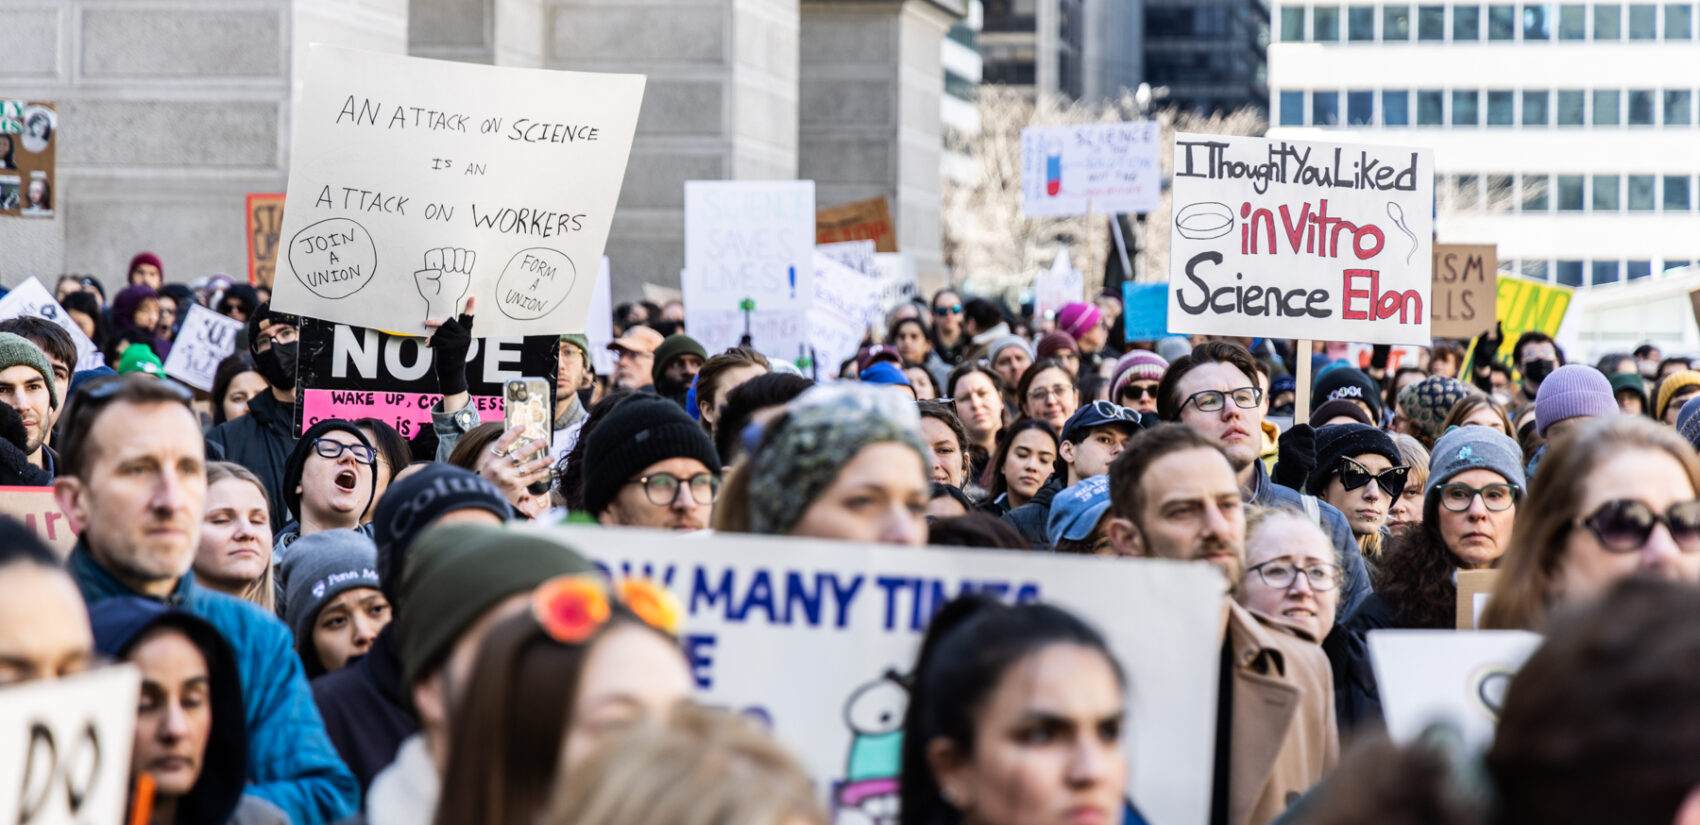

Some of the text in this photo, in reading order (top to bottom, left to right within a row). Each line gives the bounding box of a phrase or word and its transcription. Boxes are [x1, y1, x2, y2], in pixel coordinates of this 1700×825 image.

[336, 95, 600, 144] AN ATTACK ON SCIENCE
[432, 157, 487, 176] IS AN
[1176, 141, 1418, 195] I Thought You Liked
[316, 185, 587, 238] ATTACK ON WORKERS
[298, 227, 355, 255] JOIN
[704, 227, 796, 263] SAVES
[1241, 199, 1386, 261] in Vitro
[328, 250, 340, 265] A
[520, 253, 557, 281] FORM
[1432, 252, 1484, 284] ISM
[306, 264, 361, 288] UNION
[528, 277, 541, 292] A
[1176, 250, 1424, 325] Science Elon
[505, 288, 549, 312] UNION
[1431, 289, 1476, 321] LLS
[331, 391, 375, 406] WAKE
[385, 393, 412, 409] UP,
[327, 570, 360, 586] Penn
[689, 566, 865, 629] MANY
